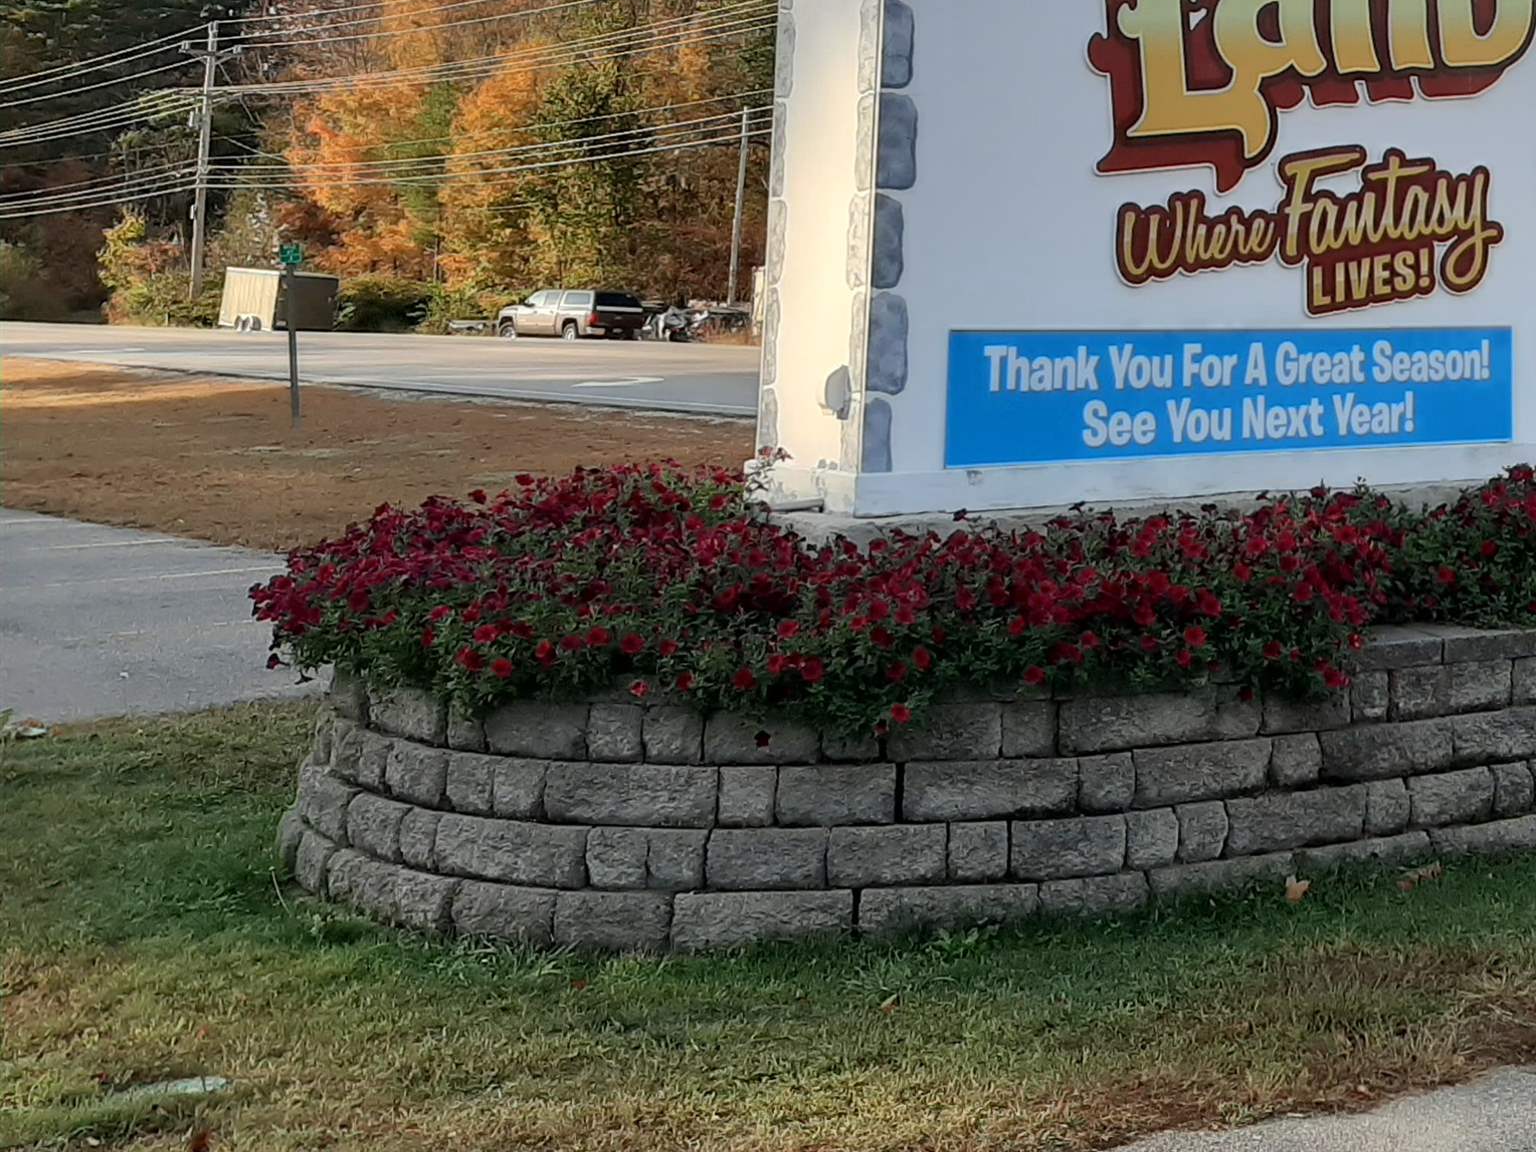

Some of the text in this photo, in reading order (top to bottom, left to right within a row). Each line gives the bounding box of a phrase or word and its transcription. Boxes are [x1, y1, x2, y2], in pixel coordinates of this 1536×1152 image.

[1120, 150, 1499, 286] Where Fantasy
[1312, 248, 1431, 307] LIVES!
[983, 338, 1491, 392] Thank You For A Great Season!
[1081, 390, 1415, 447] See You Next Year!
